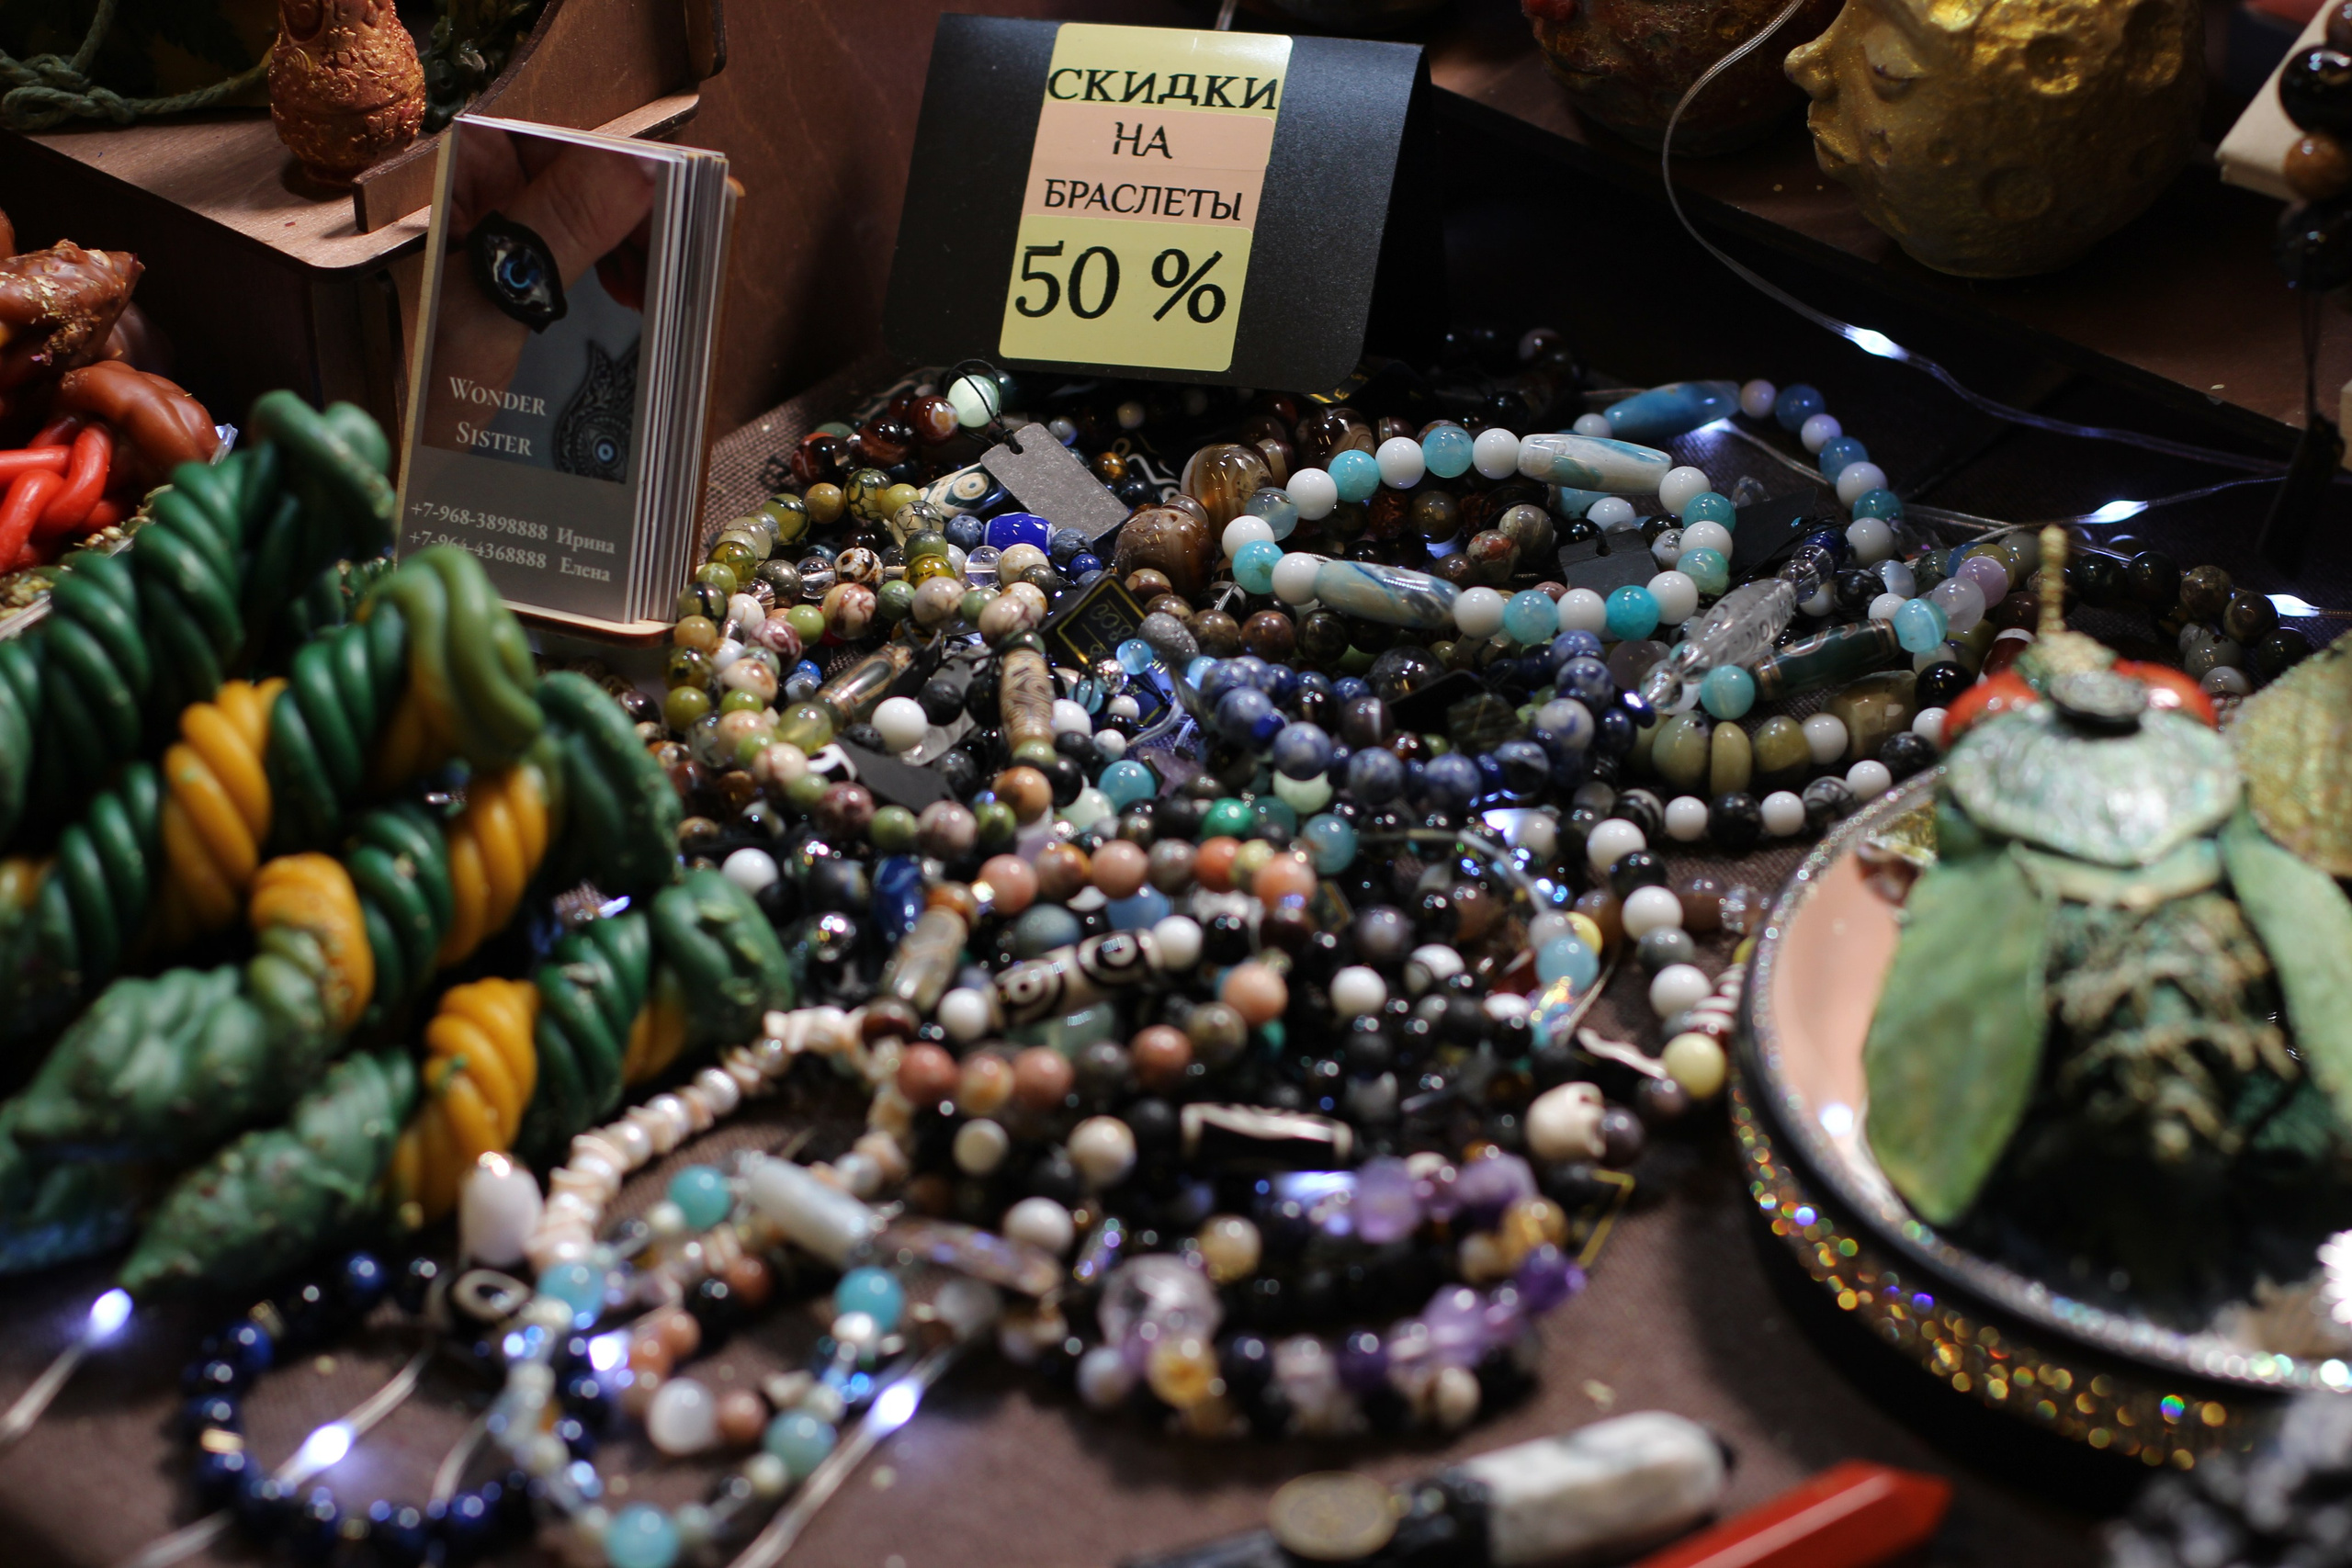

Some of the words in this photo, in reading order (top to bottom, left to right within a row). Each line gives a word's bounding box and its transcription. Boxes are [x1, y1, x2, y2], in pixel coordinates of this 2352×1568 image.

[1047, 68, 1277, 110] СКИДКИ
[1112, 121, 1173, 160] НА
[1044, 179, 1242, 221] БРАСЛЕТЫ
[1015, 240, 1120, 320] 50
[1150, 248, 1227, 324] %
[411, 502, 548, 540] +7-968-3898888
[556, 527, 616, 554] Ирина
[560, 557, 611, 581] Елена
